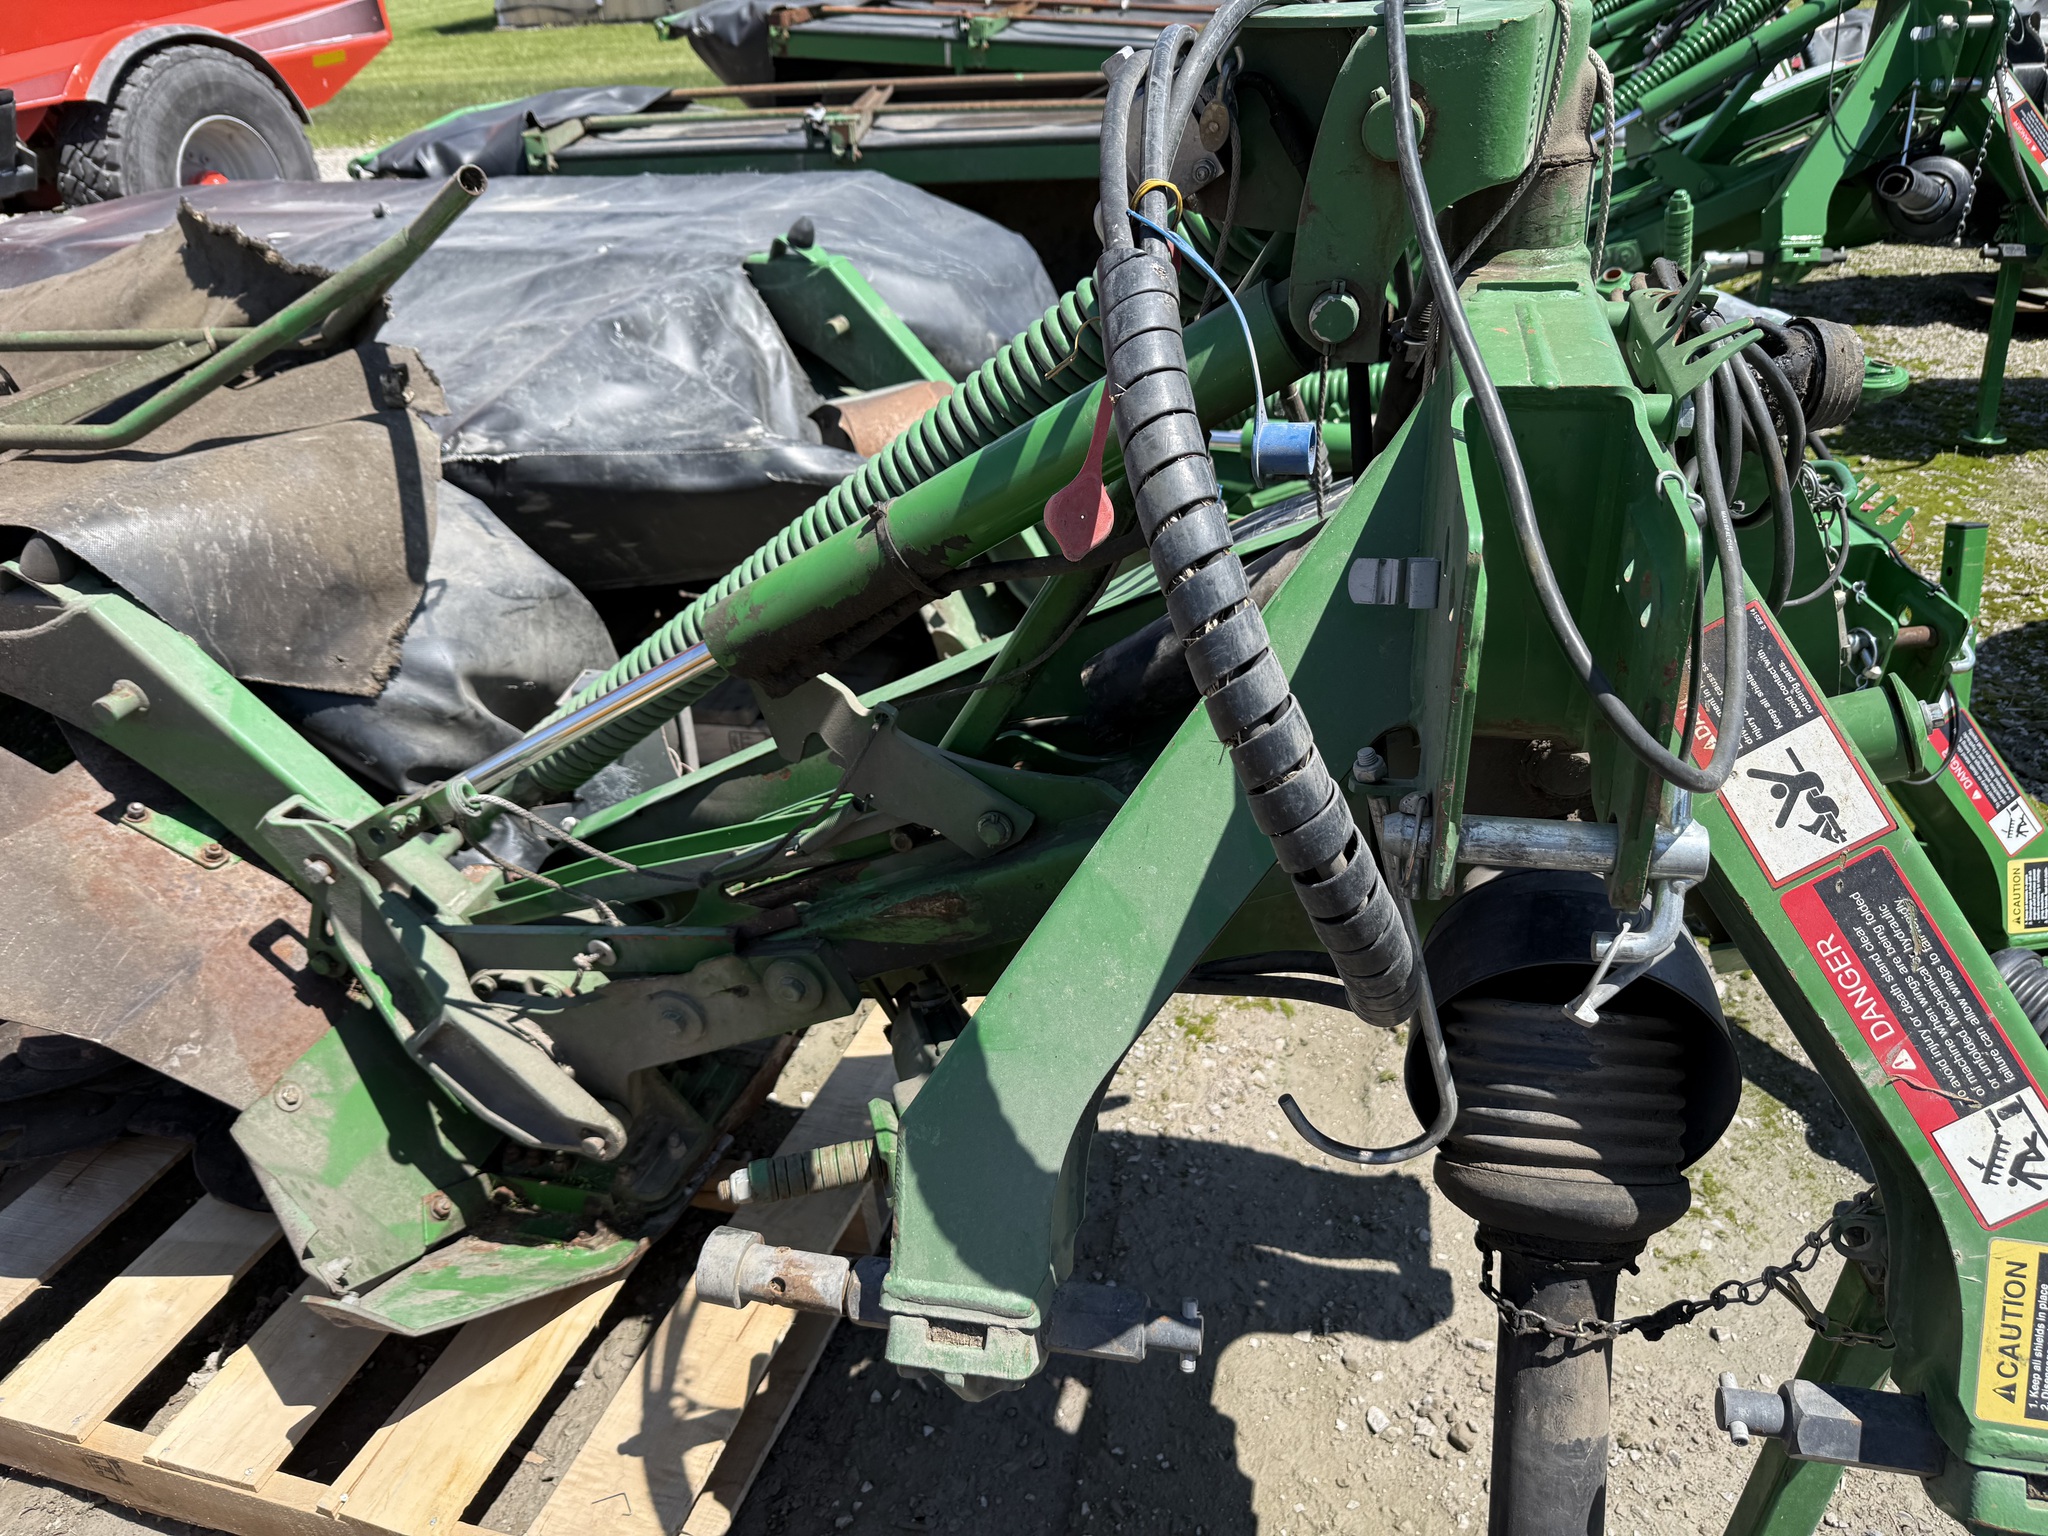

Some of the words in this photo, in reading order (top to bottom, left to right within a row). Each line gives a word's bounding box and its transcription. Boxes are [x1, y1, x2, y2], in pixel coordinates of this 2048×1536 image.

[1757, 648, 1771, 668] with
[1778, 659, 1797, 683] parts.
[1767, 666, 1790, 696] contact
[1759, 697, 1771, 709] all
[1784, 695, 1804, 719] Avoid
[1790, 682, 1814, 714] rotating
[1745, 717, 1764, 741] injury
[1767, 708, 1784, 730] Keep
[2012, 867, 2021, 915] CAUTION
[1848, 891, 1877, 926] folded
[1852, 926, 1875, 952] clear
[1872, 924, 1897, 957] being
[1878, 903, 1914, 953] hydraulic
[1868, 952, 1894, 983] stand
[1892, 956, 1909, 975] are
[1929, 952, 1941, 966] to
[1816, 933, 1895, 1042] DANGER
[1904, 975, 1929, 1008] wings
[1912, 965, 1961, 1027] Mechanical
[1936, 965, 1961, 998] wings
[1889, 983, 1914, 1014] death
[1956, 998, 1980, 1026] allow
[1909, 1016, 1922, 1028] or
[1924, 1007, 1948, 1038] when
[1976, 1026, 1994, 1048] can
[1917, 1029, 1942, 1060] injury
[1955, 1026, 1992, 1077] unfolded.
[1935, 1058, 1961, 1089] avoid
[1944, 1038, 1978, 1084] machine
[1991, 1048, 2016, 1083] failure
[1969, 1084, 1986, 1097] of
[1987, 1078, 2000, 1090] or
[2037, 1283, 2048, 1311] place
[1996, 1260, 2028, 1379] CAUTION
[2035, 1311, 2047, 1322] in
[2033, 1323, 2046, 1358] shields
[2031, 1359, 2042, 1372] all
[2028, 1372, 2043, 1398] Keep
